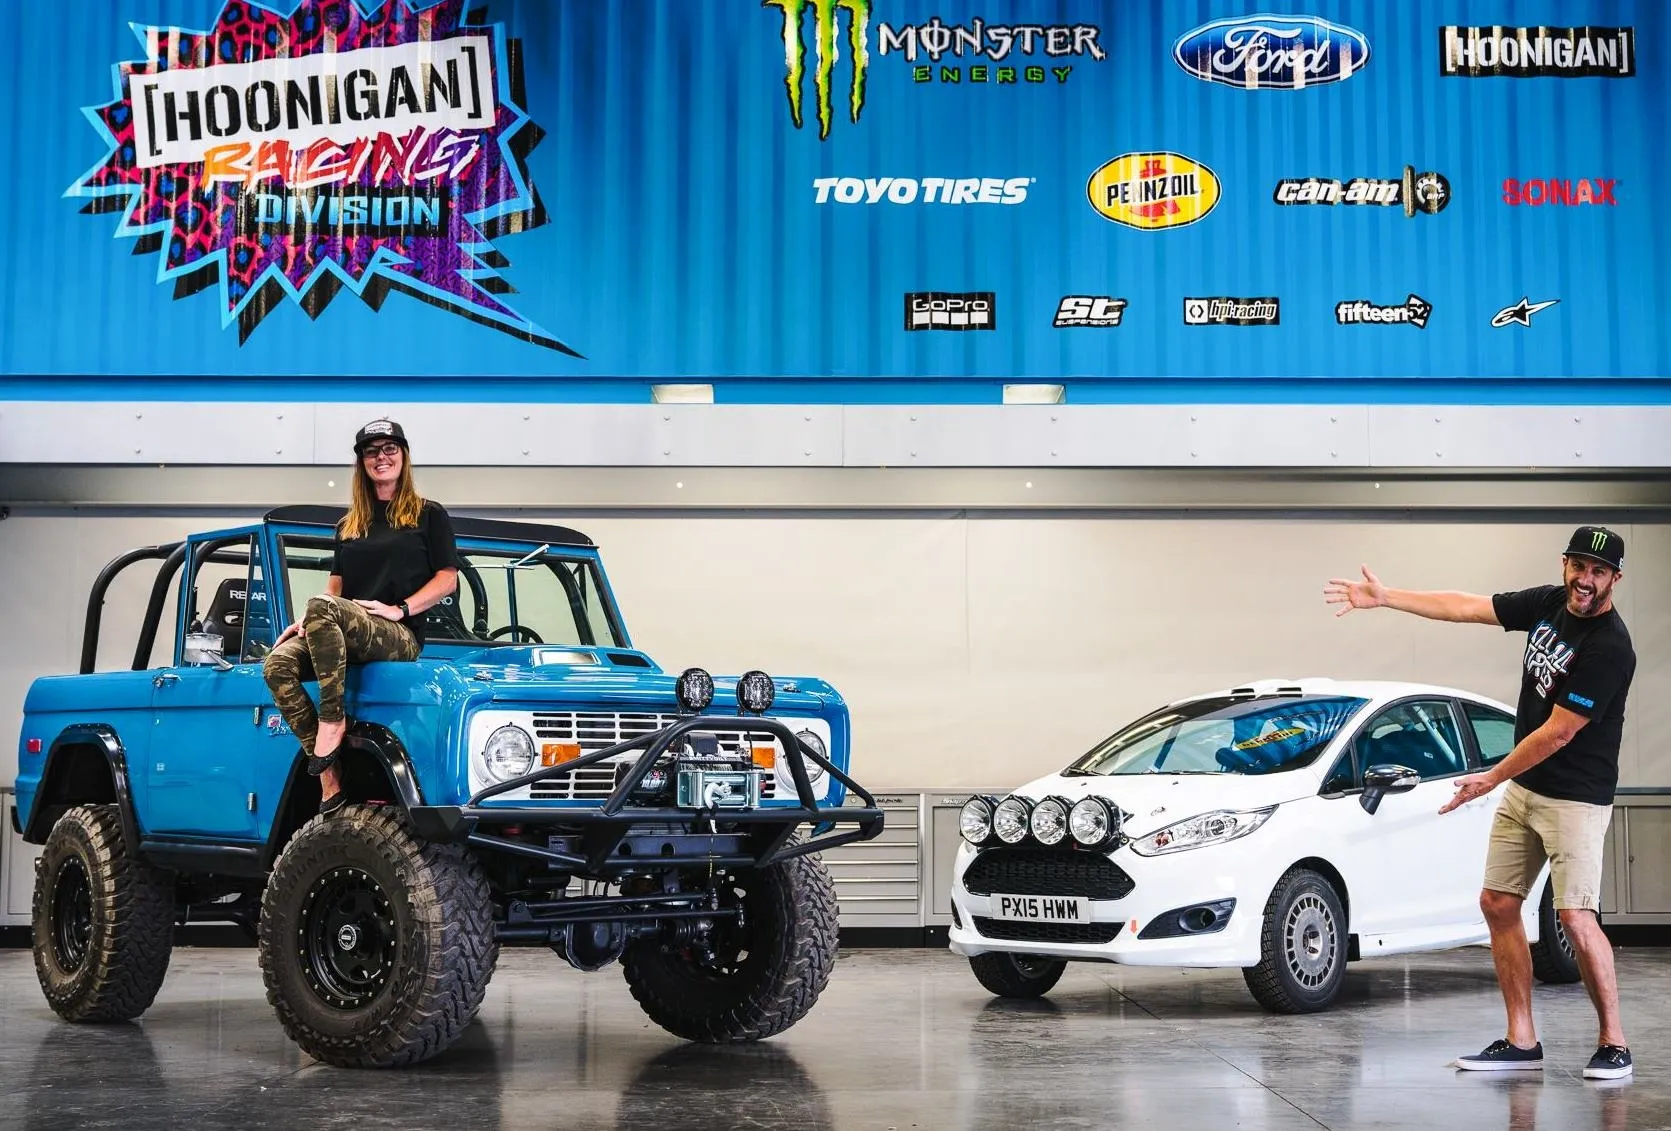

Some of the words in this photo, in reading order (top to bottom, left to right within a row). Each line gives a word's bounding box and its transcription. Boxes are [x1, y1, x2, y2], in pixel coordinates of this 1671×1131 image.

[1212, 25, 1331, 75] Ford
[914, 65, 1072, 84] ENERGY
[200, 125, 482, 193] RACING
[1107, 174, 1199, 206] PENNZOIL
[1278, 177, 1399, 203] can-am
[1503, 178, 1617, 206] SONAX
[255, 194, 440, 227] DIVISION
[912, 299, 988, 312] GoPro
[1001, 896, 1039, 918] PX15
[1043, 898, 1079, 920] HWM
